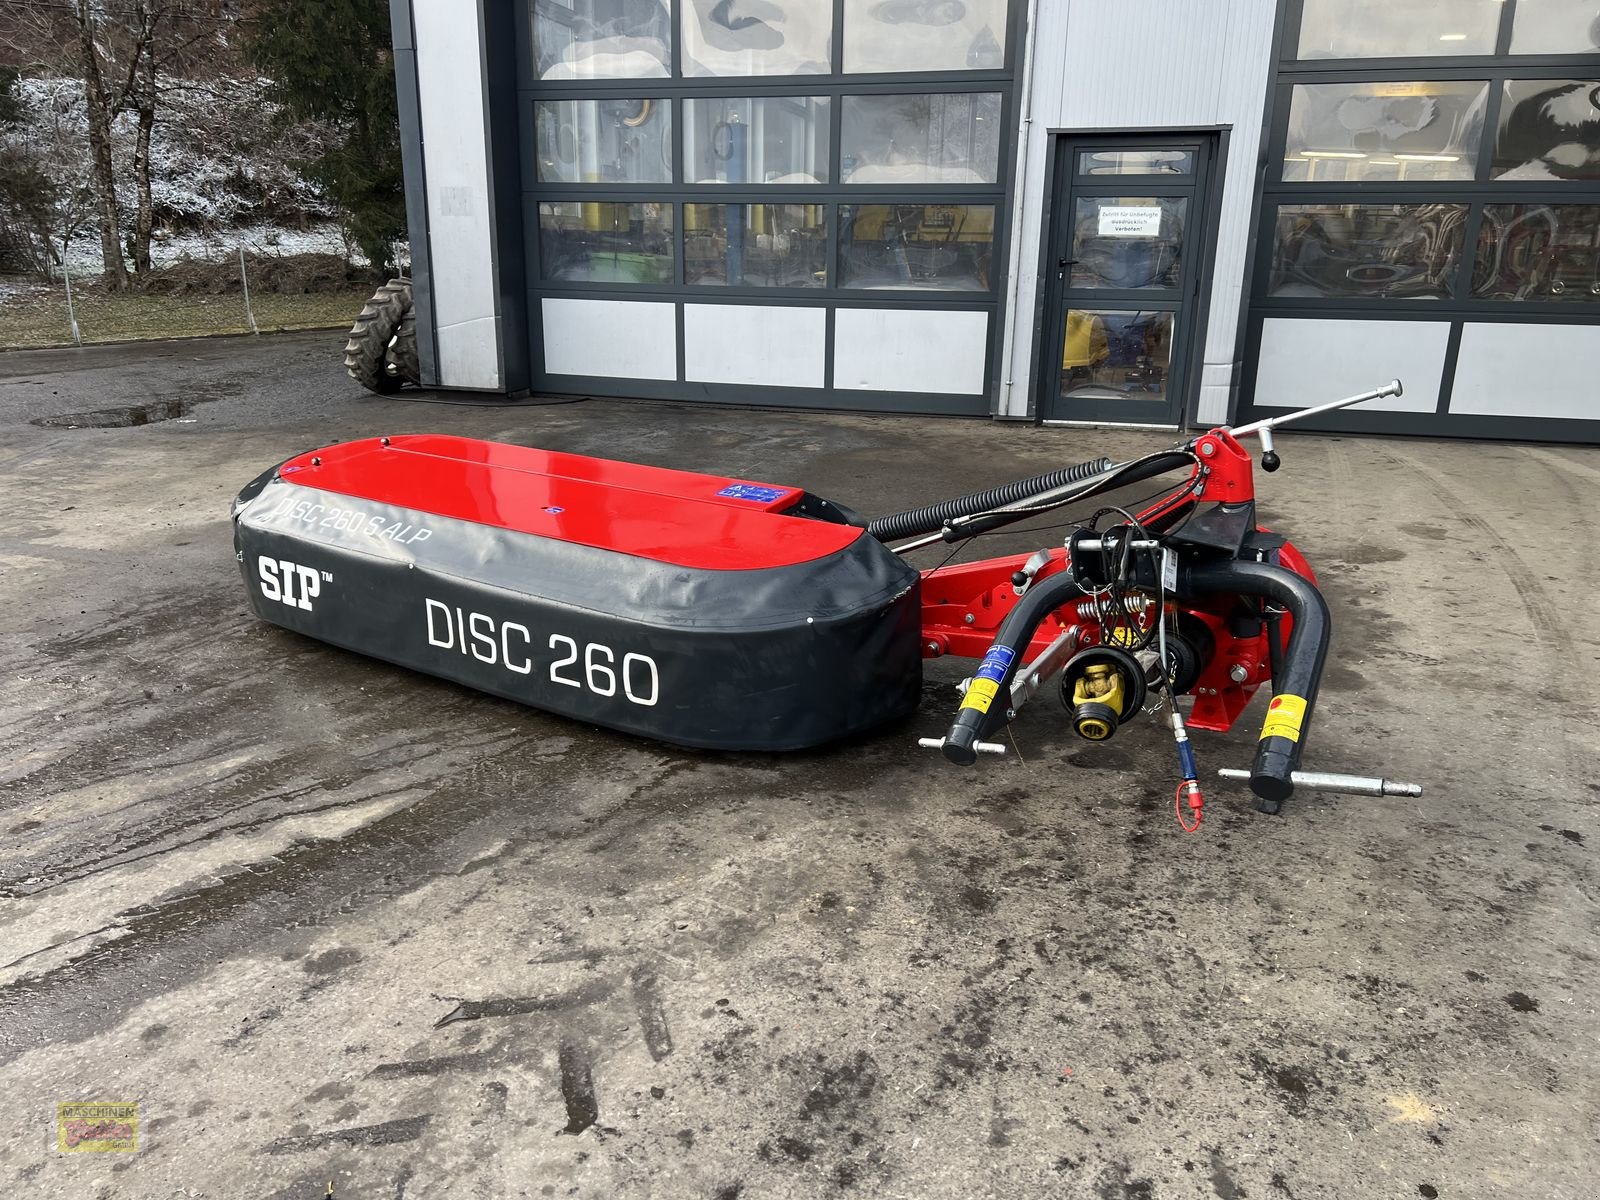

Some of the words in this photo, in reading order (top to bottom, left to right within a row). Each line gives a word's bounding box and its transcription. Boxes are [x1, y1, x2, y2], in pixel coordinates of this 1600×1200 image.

[272, 497, 325, 523] DISC
[319, 507, 367, 534] 260
[380, 522, 433, 545] ALP
[258, 555, 321, 612] SIP
[425, 597, 532, 675] DISC
[549, 633, 659, 707] 260
